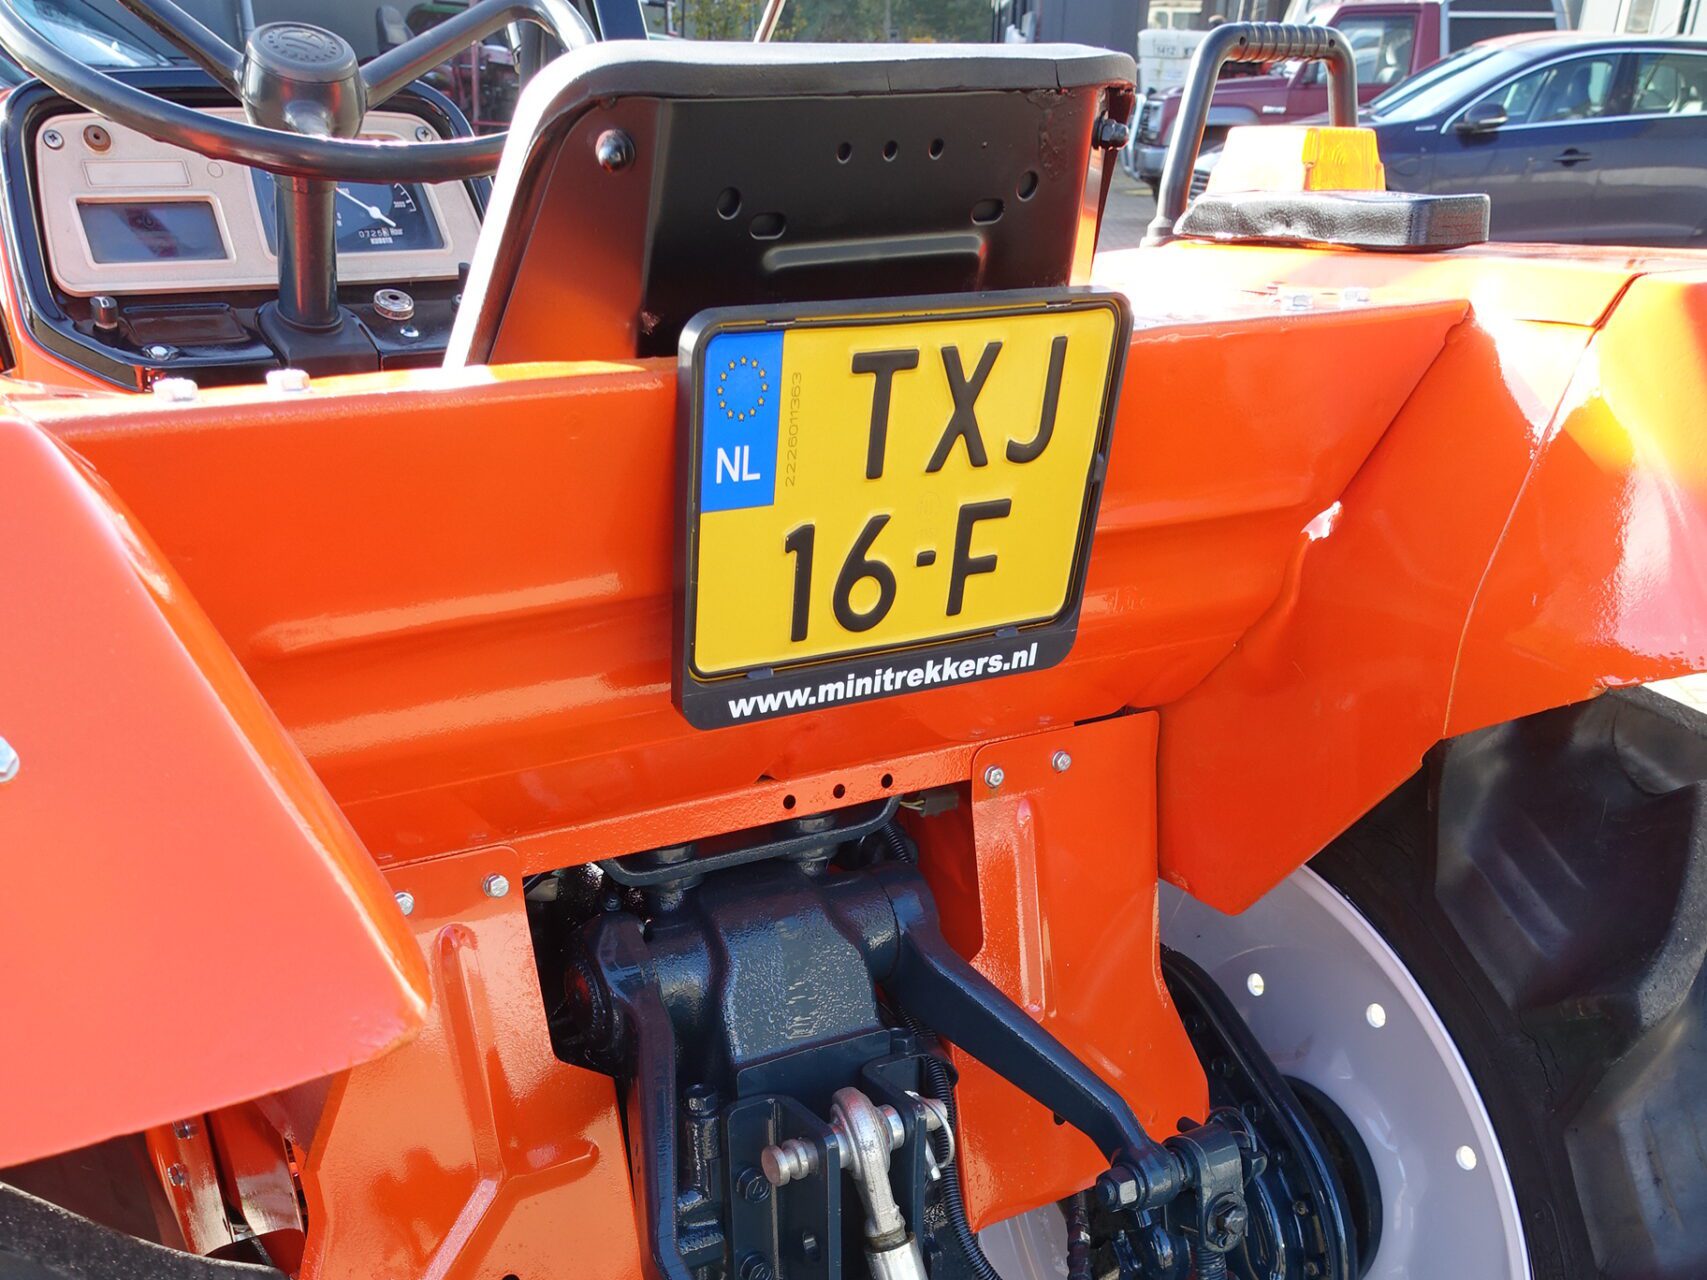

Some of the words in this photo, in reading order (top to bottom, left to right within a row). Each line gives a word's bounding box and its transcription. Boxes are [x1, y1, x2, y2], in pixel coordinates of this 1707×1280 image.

[716, 444, 761, 484] NL
[785, 371, 802, 489] 2226011363
[851, 336, 1068, 481] TXJ
[785, 498, 1012, 643] 16-F
[728, 642, 1038, 718] www.minitrekkers.nl
